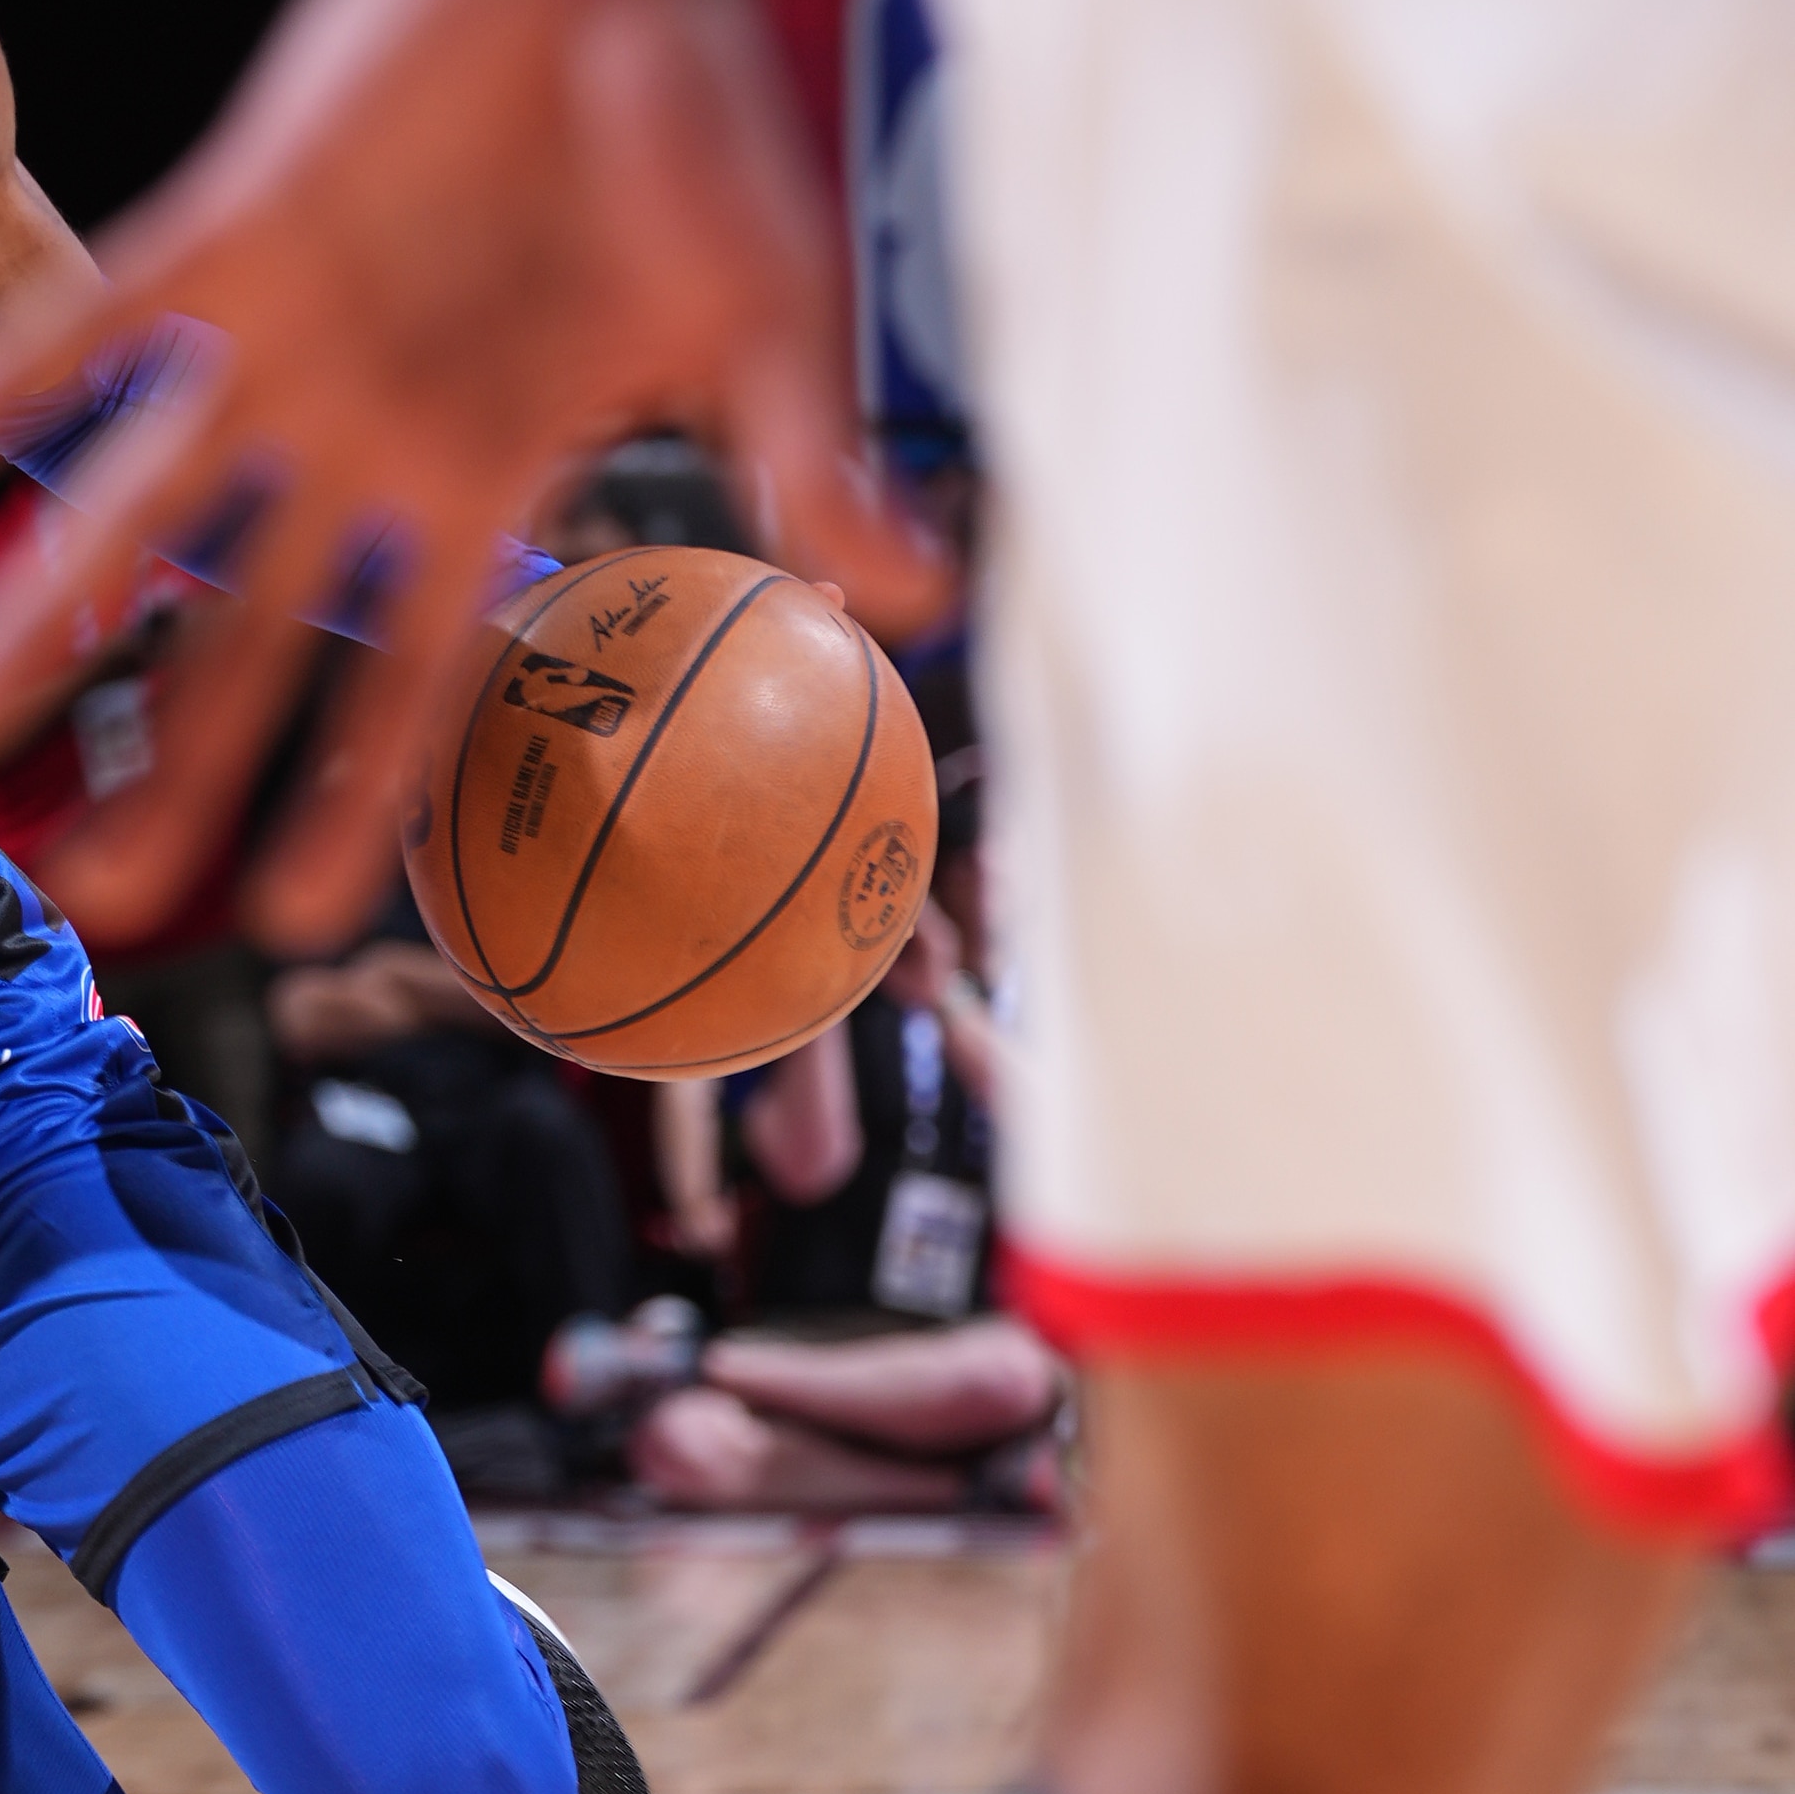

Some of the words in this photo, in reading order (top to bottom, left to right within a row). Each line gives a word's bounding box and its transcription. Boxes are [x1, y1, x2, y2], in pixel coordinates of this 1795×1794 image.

[590, 700, 622, 732] NBA
[524, 735, 549, 764] BALL
[512, 765, 536, 800] GAME
[500, 801, 526, 854] OFFICIAL
